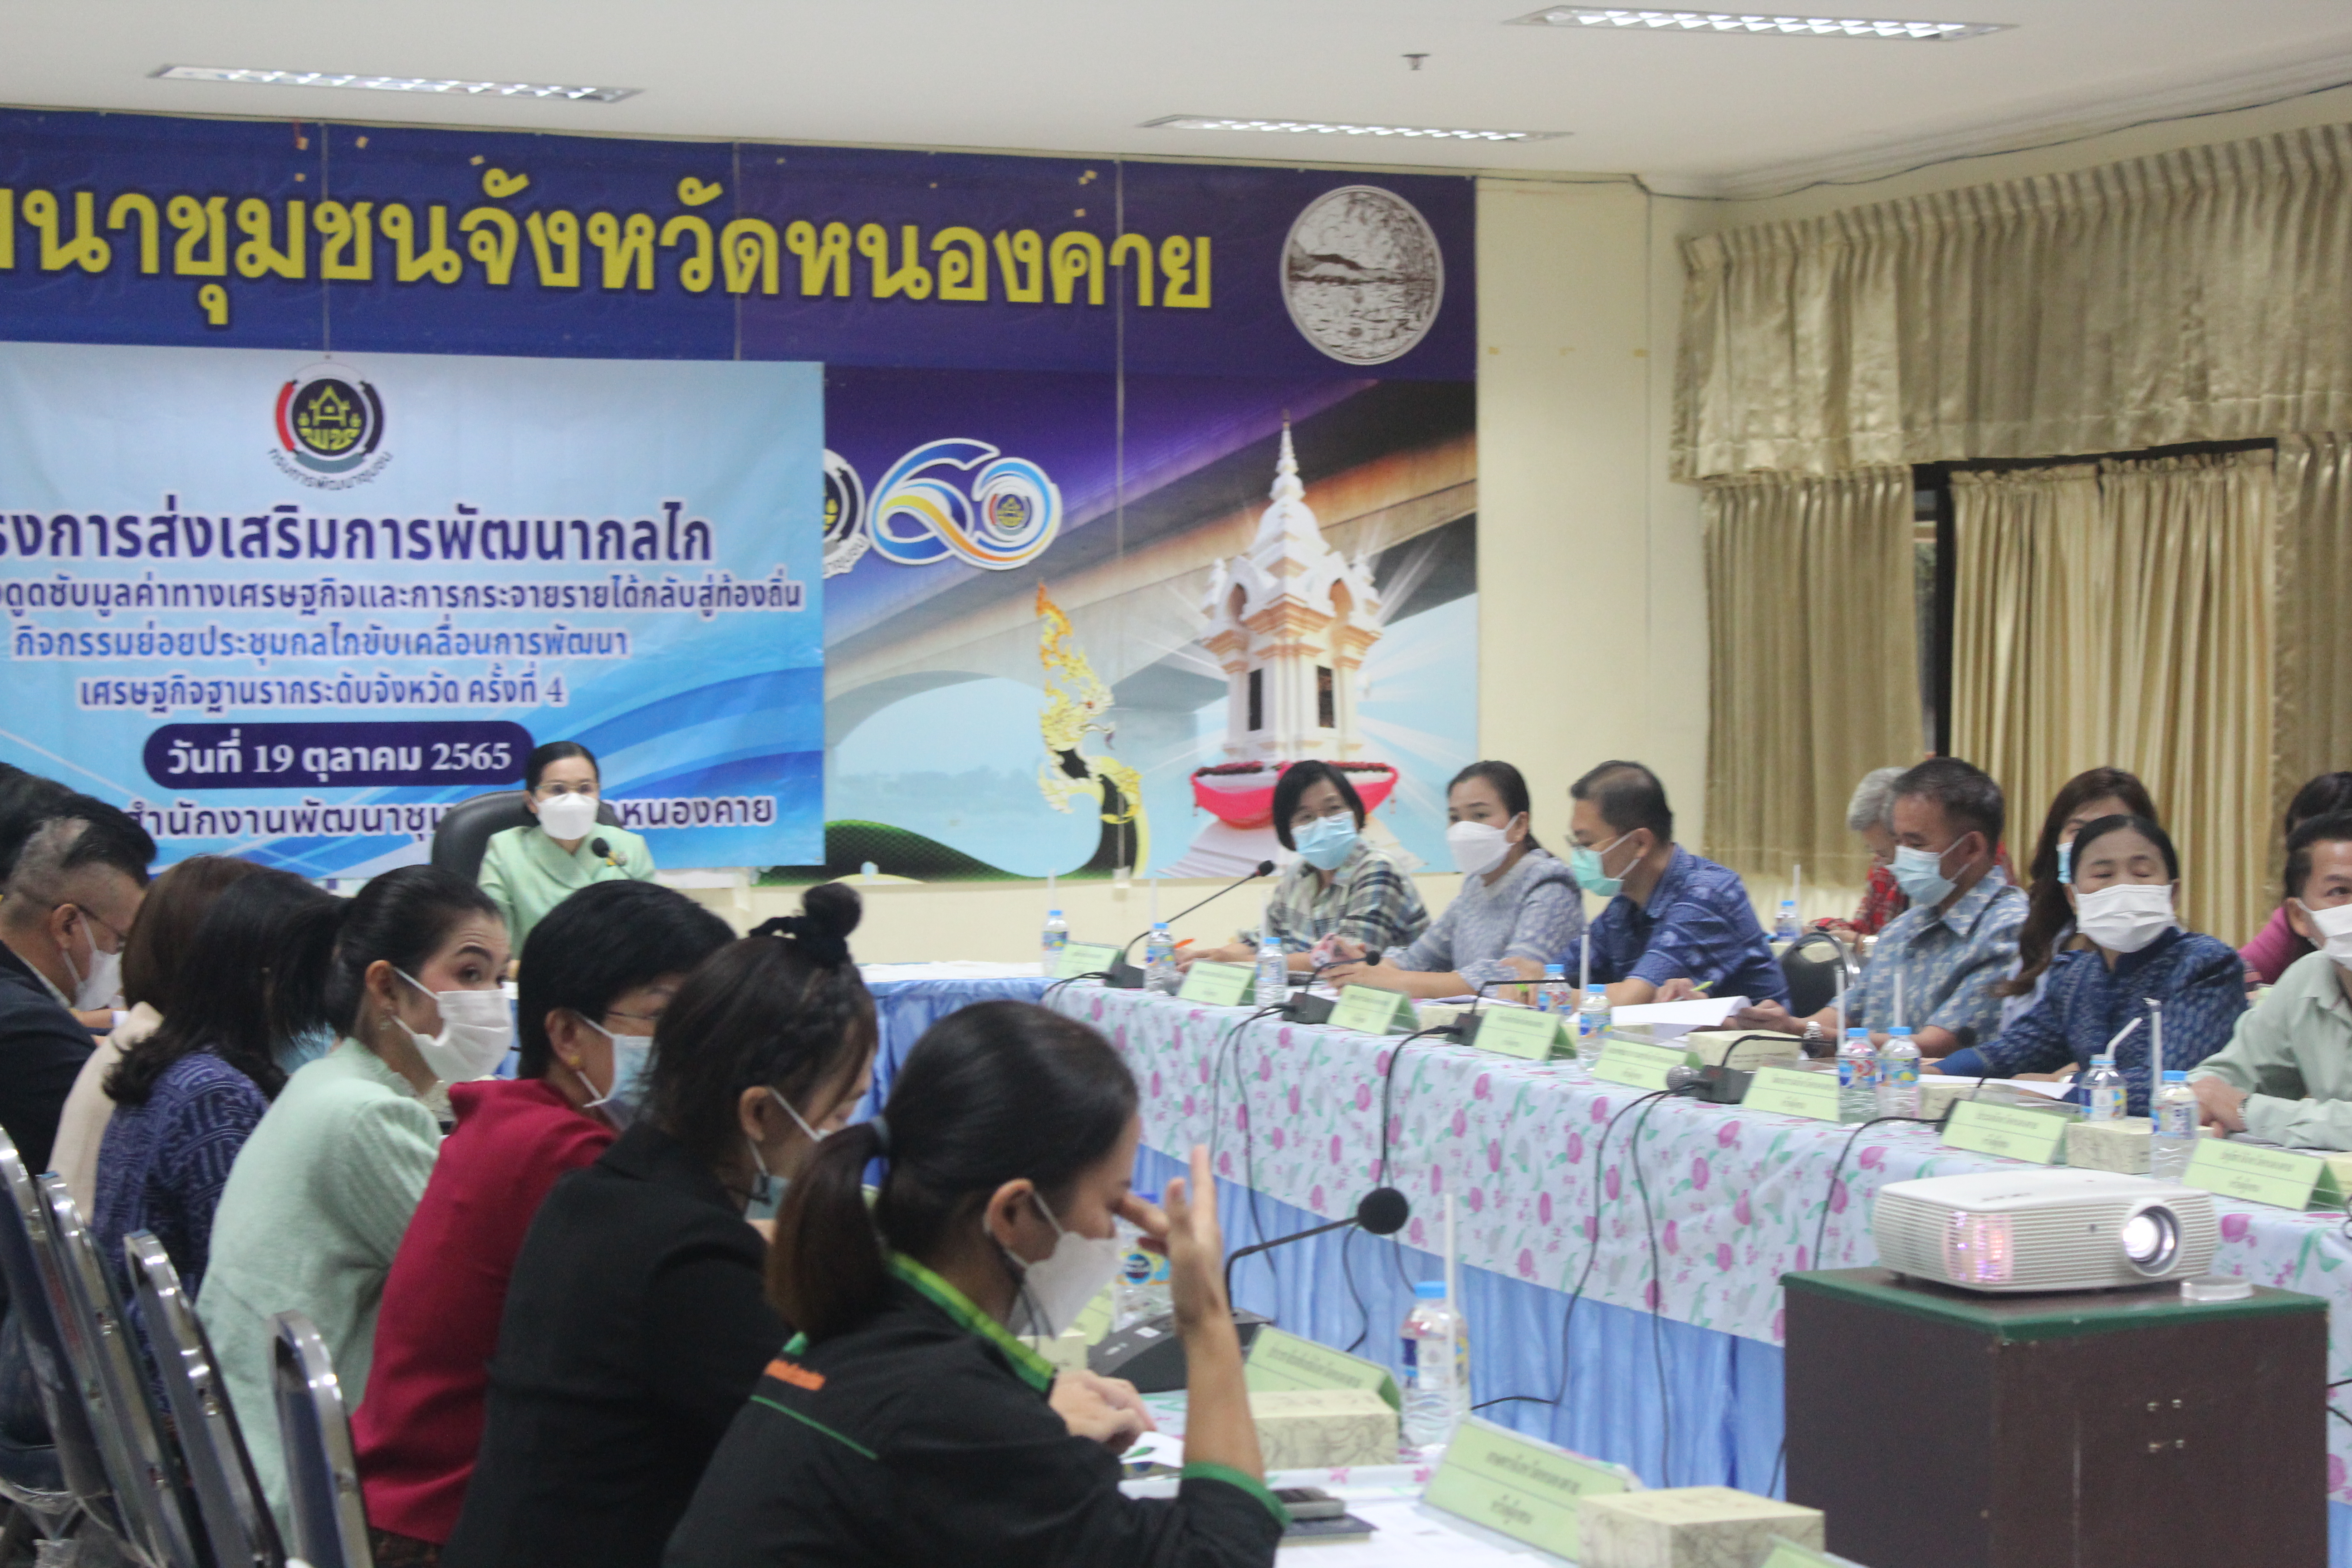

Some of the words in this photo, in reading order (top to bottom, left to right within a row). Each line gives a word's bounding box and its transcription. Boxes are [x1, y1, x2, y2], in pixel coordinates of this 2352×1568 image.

[0, 168, 1212, 325] นาชุมชนจังหวัดหนองคาย
[0, 568, 802, 617] ดูดซับมูลค่าทางเศรษฐกิจและการกระจายรายได้กลับสู่ท้องถิ่น
[16, 614, 627, 666] กิจกรรมย่อยประชุมกลไกขับเคลื่อนการพัฒนา
[81, 671, 459, 713] เศรษฐกิจฐานรากระดับจังหวัด
[470, 661, 537, 703] ครั้งที่
[547, 677, 564, 703] 4
[167, 728, 242, 774] วันที่
[253, 744, 294, 773] 19
[302, 746, 422, 783] ตุลาคม
[430, 742, 512, 771] 2565
